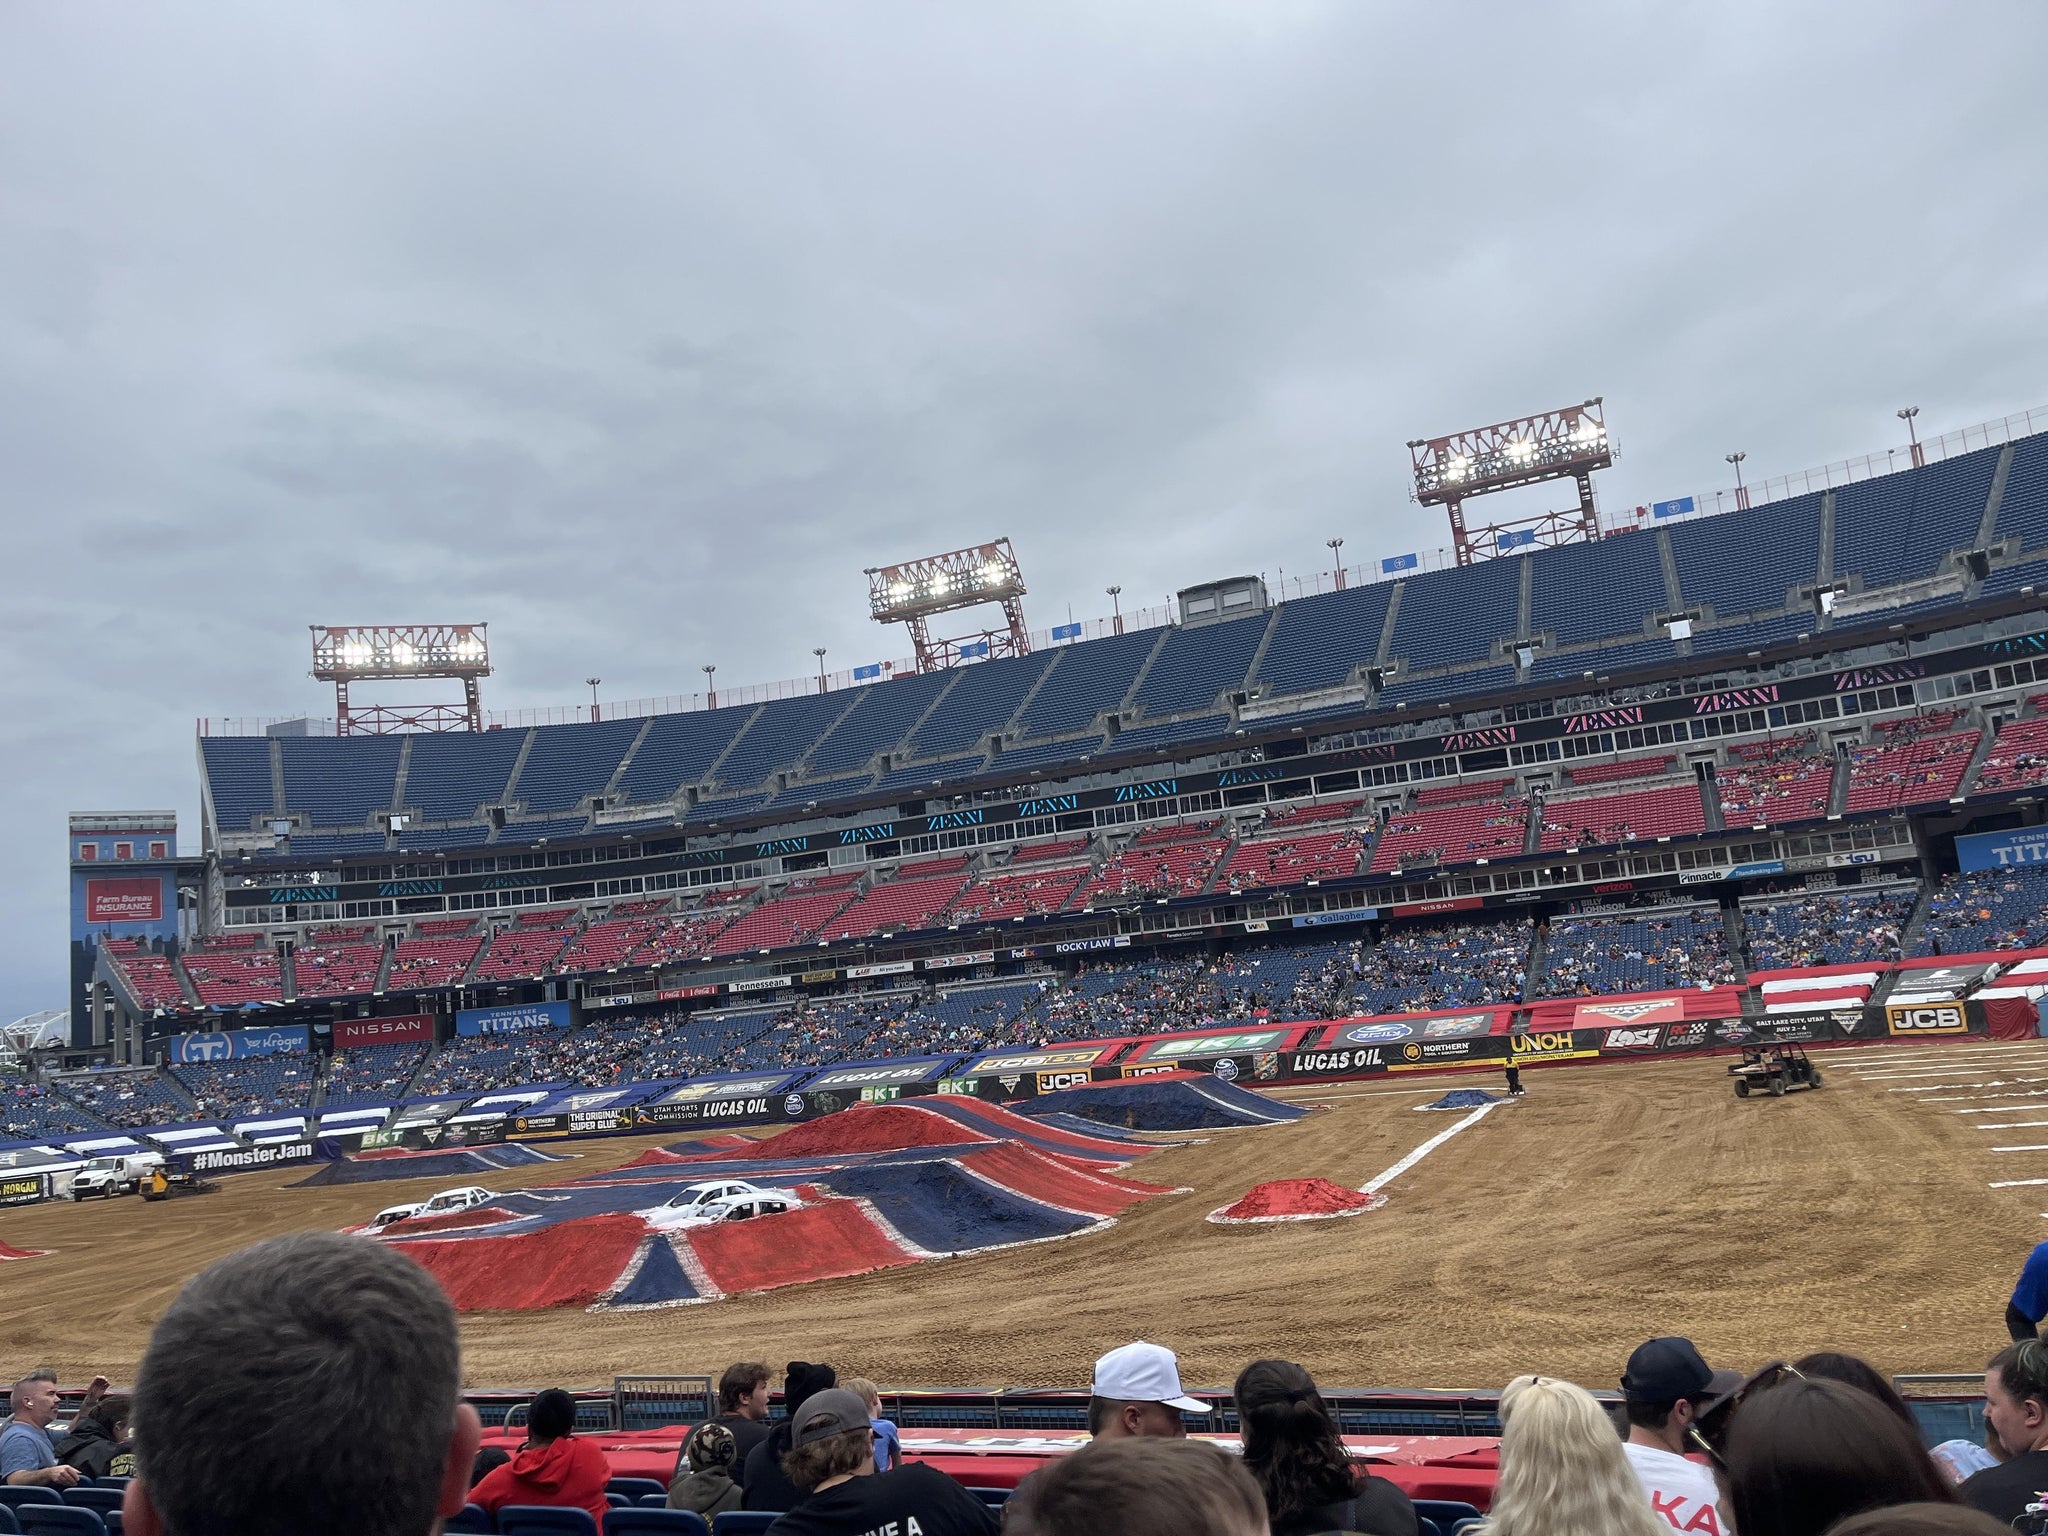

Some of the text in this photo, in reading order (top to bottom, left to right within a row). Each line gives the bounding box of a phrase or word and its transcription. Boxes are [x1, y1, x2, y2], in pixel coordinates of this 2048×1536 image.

[1693, 685, 1780, 714] ZENNI
[1563, 706, 1644, 734] ZENNI
[1440, 726, 1516, 752] ZENNI
[1115, 780, 1177, 801] ZENNI
[1018, 795, 1078, 816] ZENNI
[927, 810, 983, 831] ZENNI
[839, 824, 894, 844] ZENNI
[757, 838, 808, 857] ZENNI
[1680, 870, 1722, 884] Pinnacle
[1805, 872, 1837, 882] FLOYD
[1861, 873, 1898, 885] FISHER
[269, 886, 338, 903] ZENNI
[379, 880, 443, 896] ZENNI
[1592, 881, 1633, 893] verizon
[96, 894, 153, 903] Farm Bureau
[96, 902, 152, 912] INSURANCE
[1420, 902, 1454, 911] NISSAN
[1582, 903, 1626, 914] JOHNSON
[1320, 911, 1366, 923] Gallagher
[1012, 947, 1036, 958] FedEx
[1056, 938, 1111, 953] ROCKY LAW
[735, 979, 785, 991] Tennessean
[490, 1008, 537, 1017] TENNESSEE
[1894, 1008, 1962, 1029] JCB
[346, 1020, 421, 1036] NISSAN
[478, 1012, 551, 1032] TITANS
[1669, 1024, 1690, 1035] RC
[263, 1032, 304, 1053] Kroger
[1161, 1034, 1274, 1052] BKT
[1423, 1042, 1470, 1053] NORTHERN
[1510, 1031, 1573, 1053] UNOH
[1666, 1033, 1705, 1047] CARS
[1293, 1051, 1350, 1071] LUCAS
[819, 1072, 886, 1084] LUCAS
[1041, 1073, 1088, 1090] JCB
[860, 1086, 900, 1101] BKT
[938, 1079, 977, 1095] BKT
[570, 1110, 620, 1122] THE ORIGINAL
[653, 1104, 698, 1113] UTAH SPORTS
[702, 1100, 745, 1118] LUCAS
[653, 1112, 698, 1121] COMMISSION
[570, 1119, 617, 1131] SUPER GLUE
[361, 1130, 403, 1147] BKT
[193, 1142, 313, 1171] #MonsterJam
[3, 1181, 37, 1196] MORGAN
[907, 1516, 923, 1536] A
